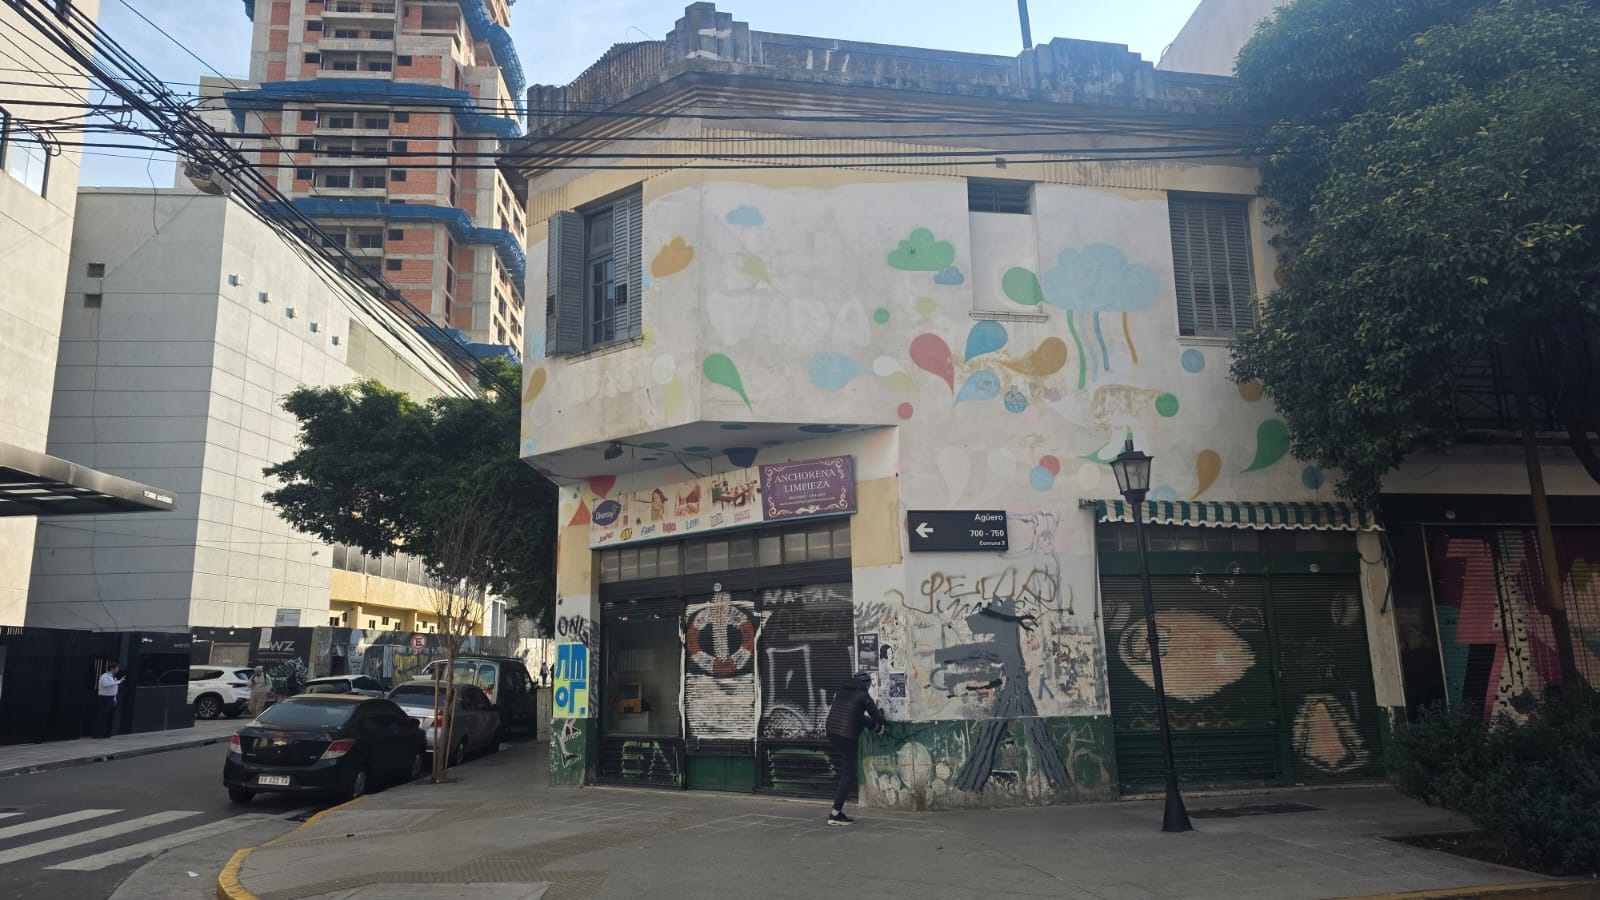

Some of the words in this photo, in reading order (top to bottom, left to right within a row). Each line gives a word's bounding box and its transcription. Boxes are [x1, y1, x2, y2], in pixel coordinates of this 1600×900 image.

[775, 468, 836, 483] ANCHORENA
[784, 480, 831, 493] LIMPIEZA
[974, 513, 1003, 522] Agüero
